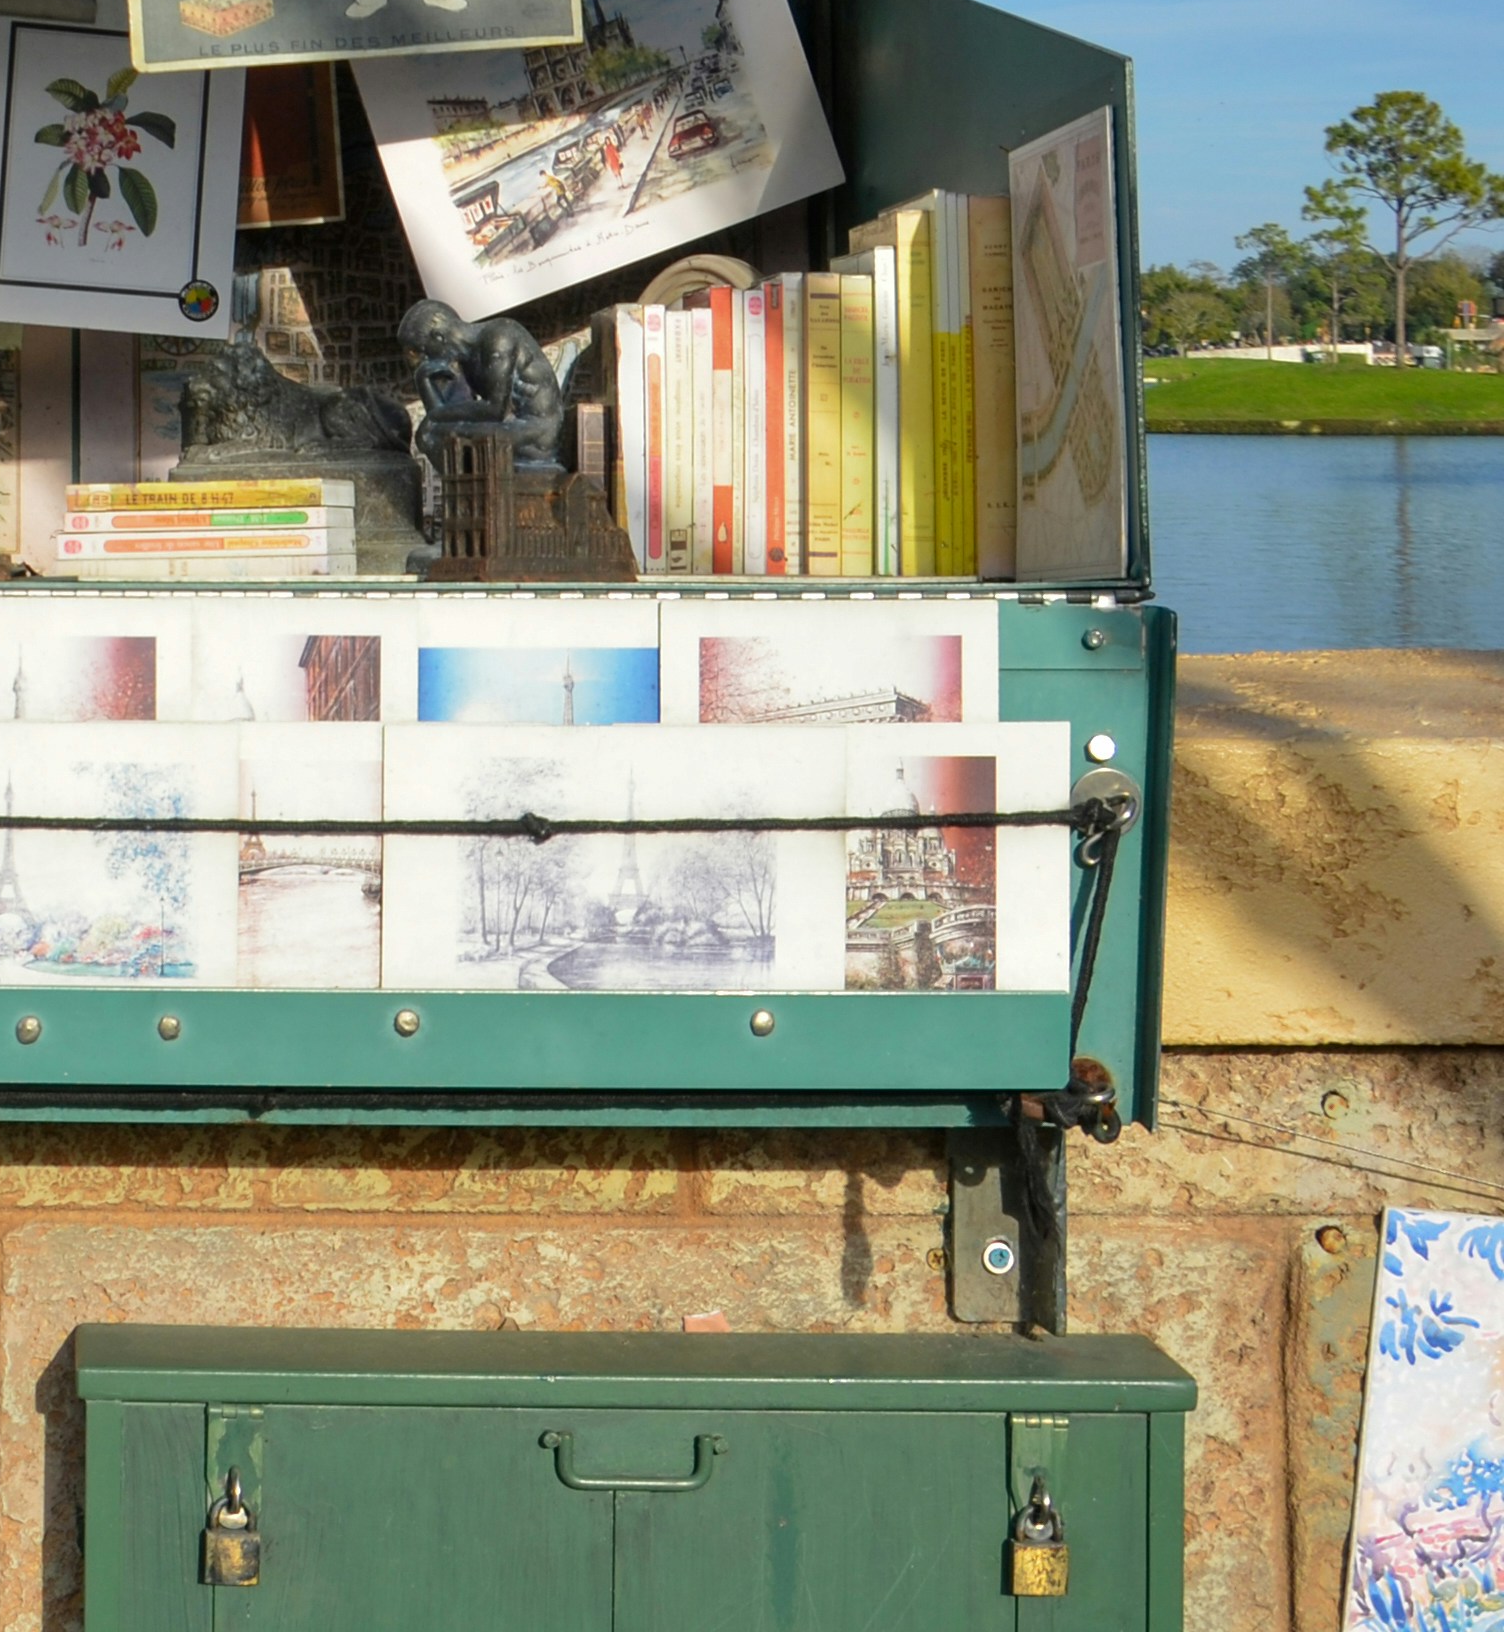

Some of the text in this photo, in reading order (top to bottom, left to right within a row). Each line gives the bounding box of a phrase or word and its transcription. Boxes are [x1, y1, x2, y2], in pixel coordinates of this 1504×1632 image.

[199, 25, 516, 57] LE PLUS FIN DES MEILLEURS
[789, 368, 797, 461] MARIE ANTOINETTE
[126, 493, 138, 506] LE
[143, 493, 178, 504] TRAIN
[182, 493, 196, 504] DE
